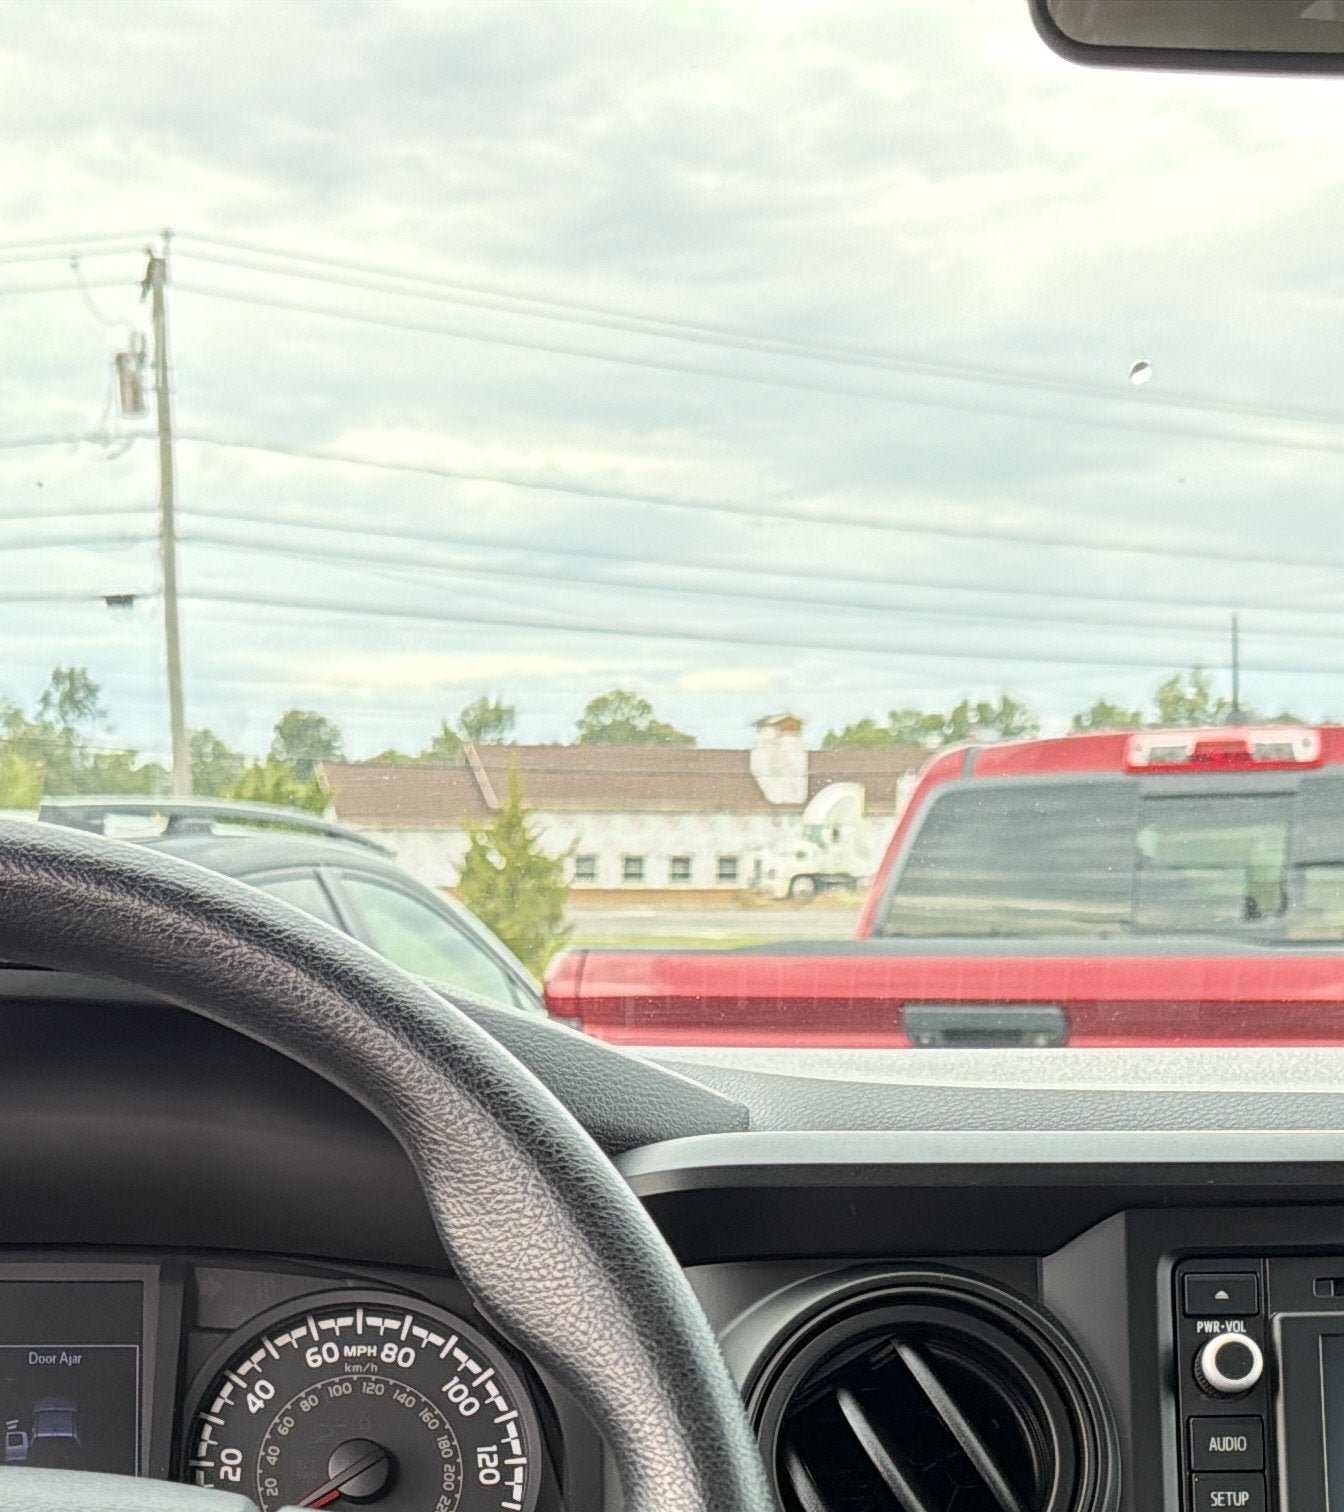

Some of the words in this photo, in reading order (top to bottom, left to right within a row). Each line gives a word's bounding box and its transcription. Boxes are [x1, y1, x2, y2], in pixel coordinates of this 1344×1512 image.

[28, 1351, 56, 1365] Door
[59, 1351, 83, 1368] Ajar
[305, 1342, 341, 1369] 60
[343, 1345, 377, 1357] MPH
[379, 1342, 416, 1369] 80
[343, 1362, 379, 1374] km/h
[246, 1379, 276, 1415] 40
[327, 1381, 353, 1399] 100
[361, 1380, 385, 1397] 120
[391, 1388, 417, 1410] 140
[441, 1375, 481, 1418] 100
[298, 1395, 320, 1414] 80
[276, 1415, 296, 1437] 60
[418, 1406, 441, 1431] 160
[435, 1434, 454, 1460] 180
[1208, 1435, 1248, 1453] AUDIO
[219, 1447, 243, 1483] 20
[266, 1445, 281, 1467] 40
[476, 1444, 501, 1486] 120
[265, 1477, 280, 1497] 20
[442, 1463, 456, 1492] 200
[1210, 1490, 1250, 1508] SETUP
